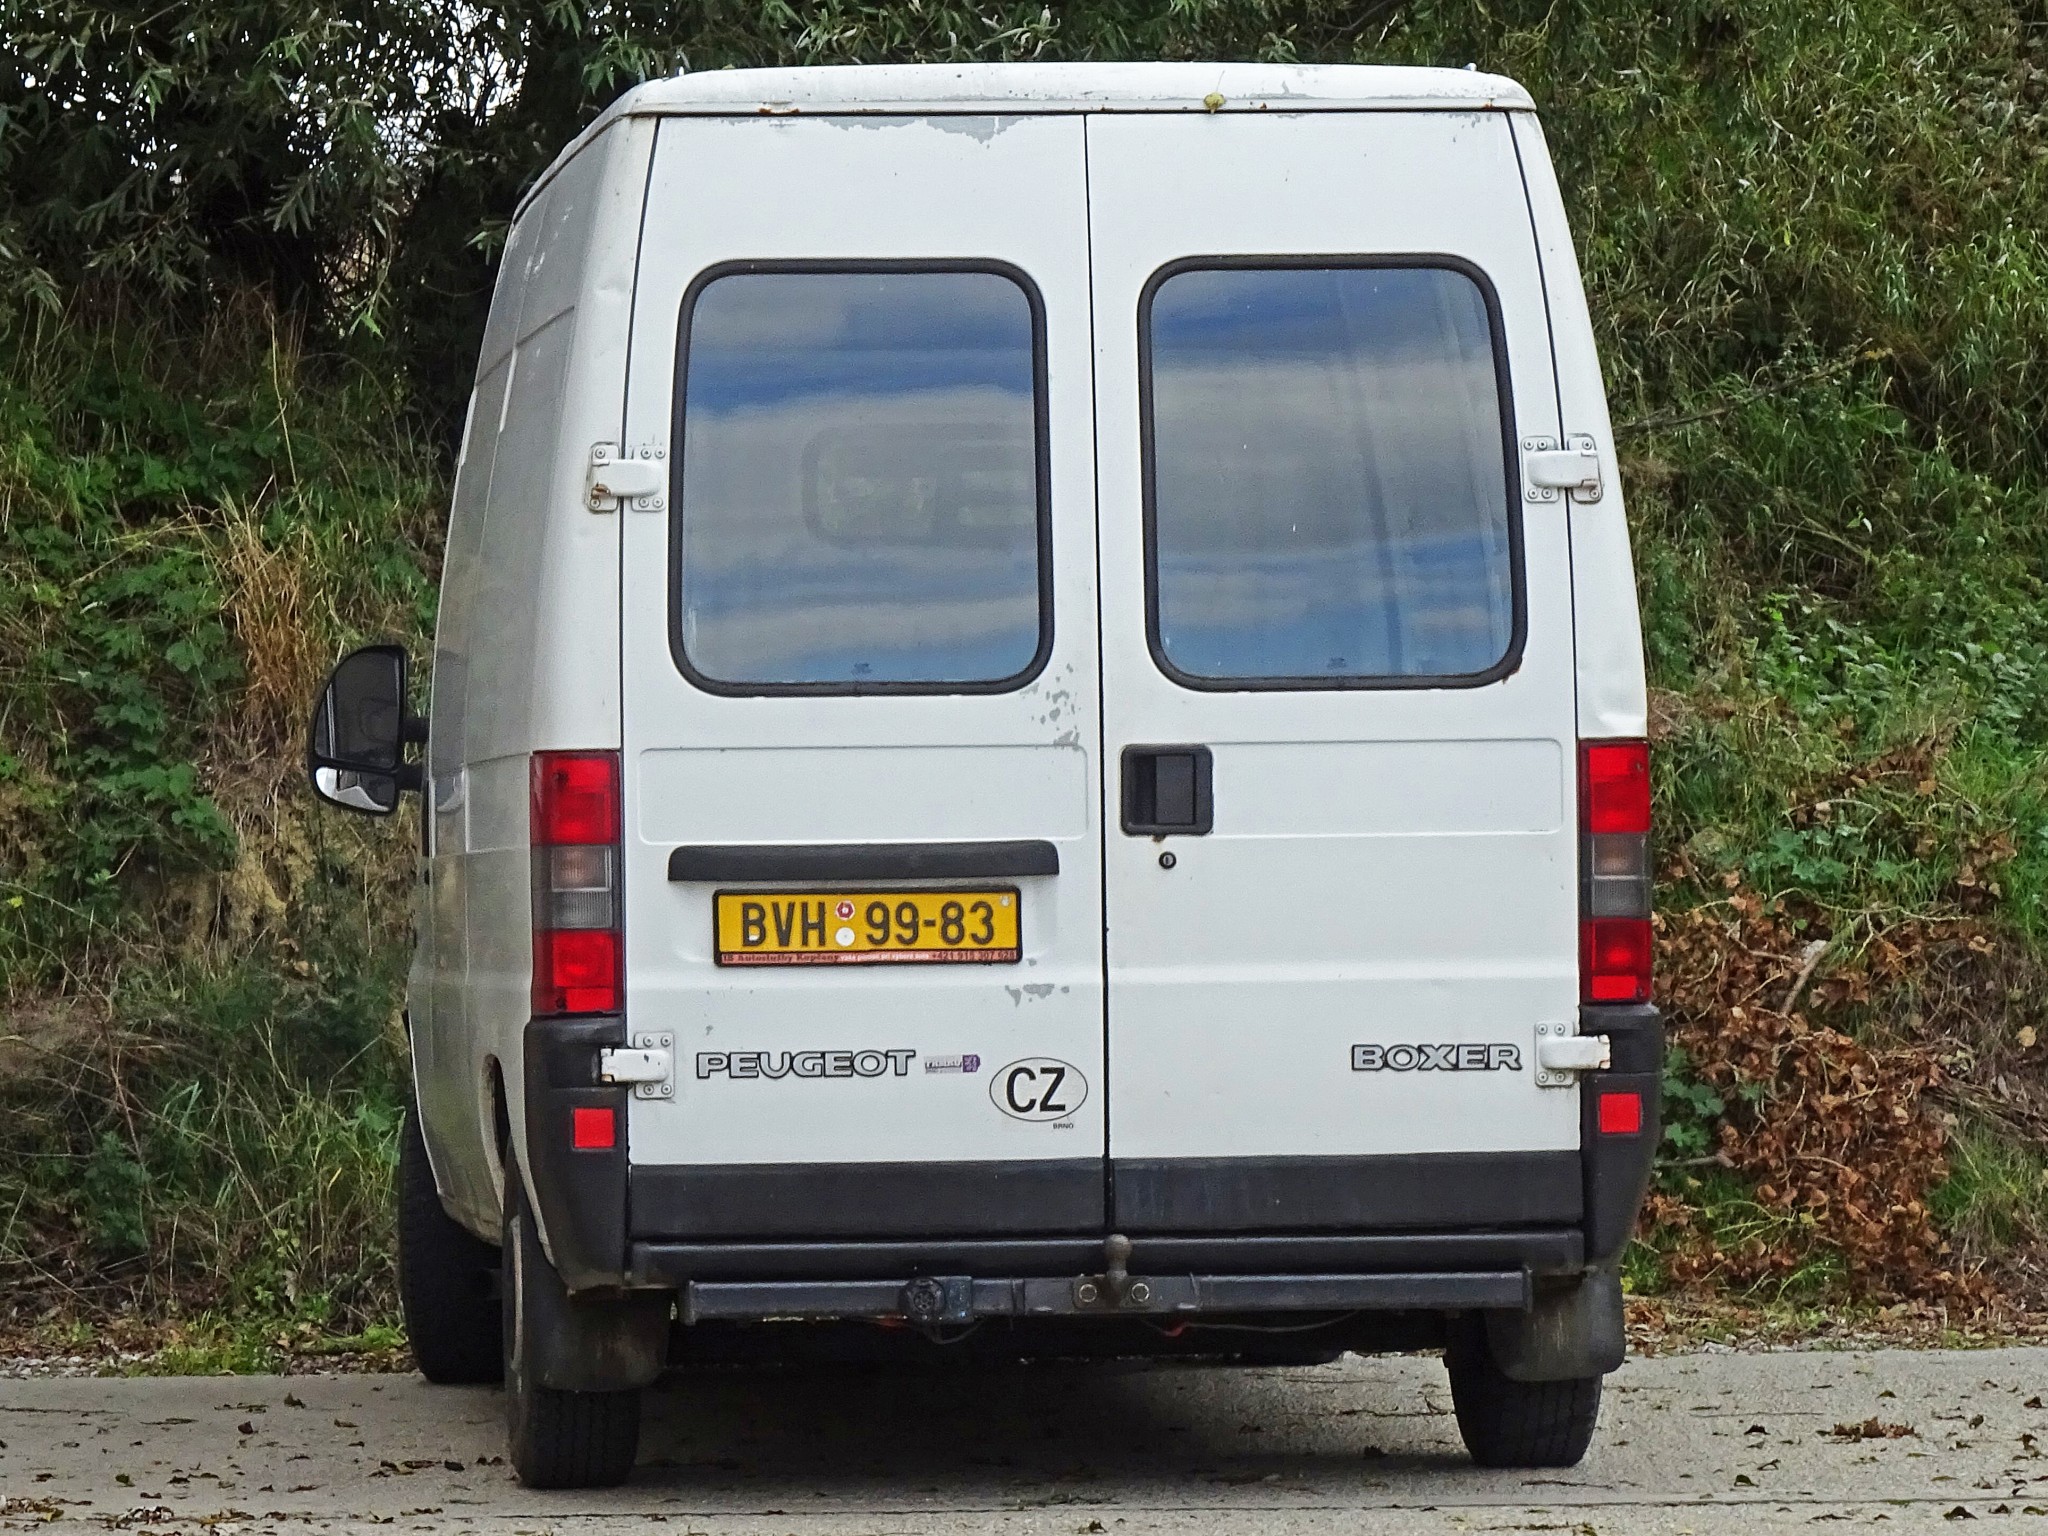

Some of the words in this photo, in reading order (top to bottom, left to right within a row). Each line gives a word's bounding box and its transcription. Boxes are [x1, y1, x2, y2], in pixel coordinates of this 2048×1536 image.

[741, 901, 826, 947] BVH
[866, 900, 994, 945] 99-83
[696, 1050, 916, 1079] PEUGEOT
[1352, 1044, 1522, 1071] BOXER
[1006, 1067, 1066, 1113] CZ
